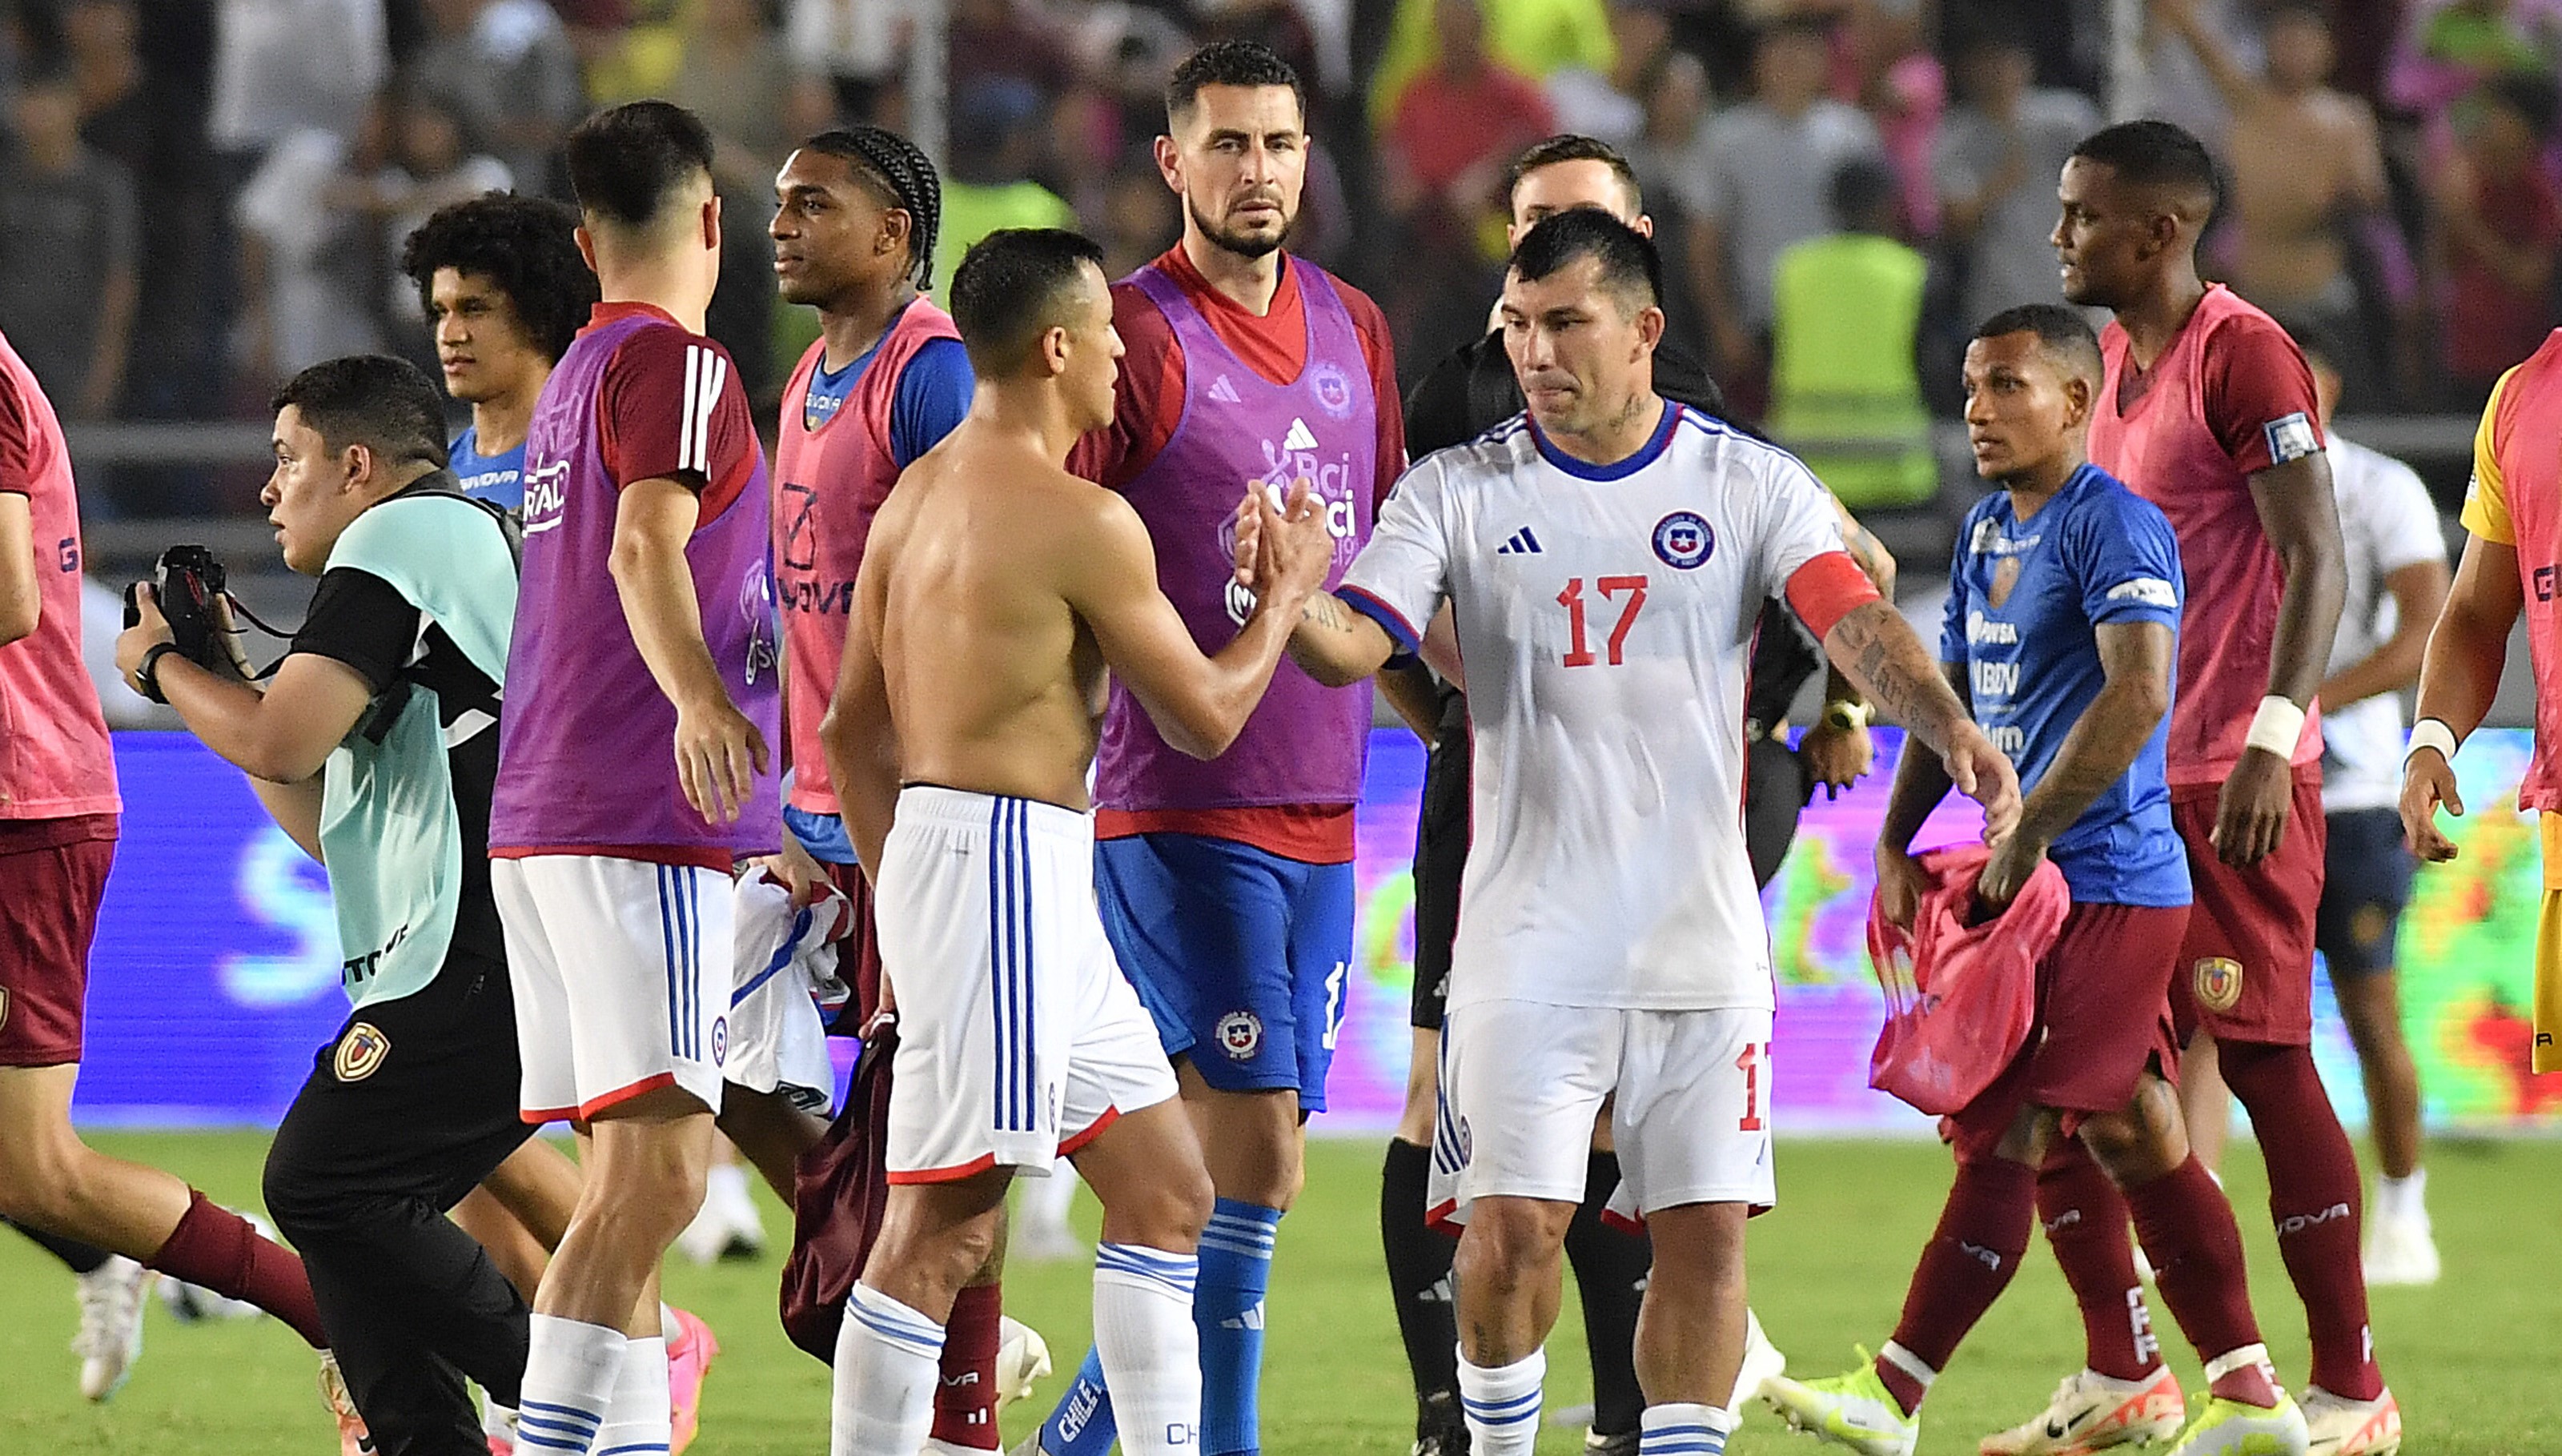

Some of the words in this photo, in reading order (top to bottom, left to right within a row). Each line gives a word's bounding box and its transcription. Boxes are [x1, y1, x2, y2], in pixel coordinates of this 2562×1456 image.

[1307, 489, 1356, 539] ci
[1556, 575, 1649, 668] 17
[1322, 961, 1353, 1050] 1
[1735, 1041, 1773, 1132] 1
[1057, 1378, 1098, 1443] CHILE
